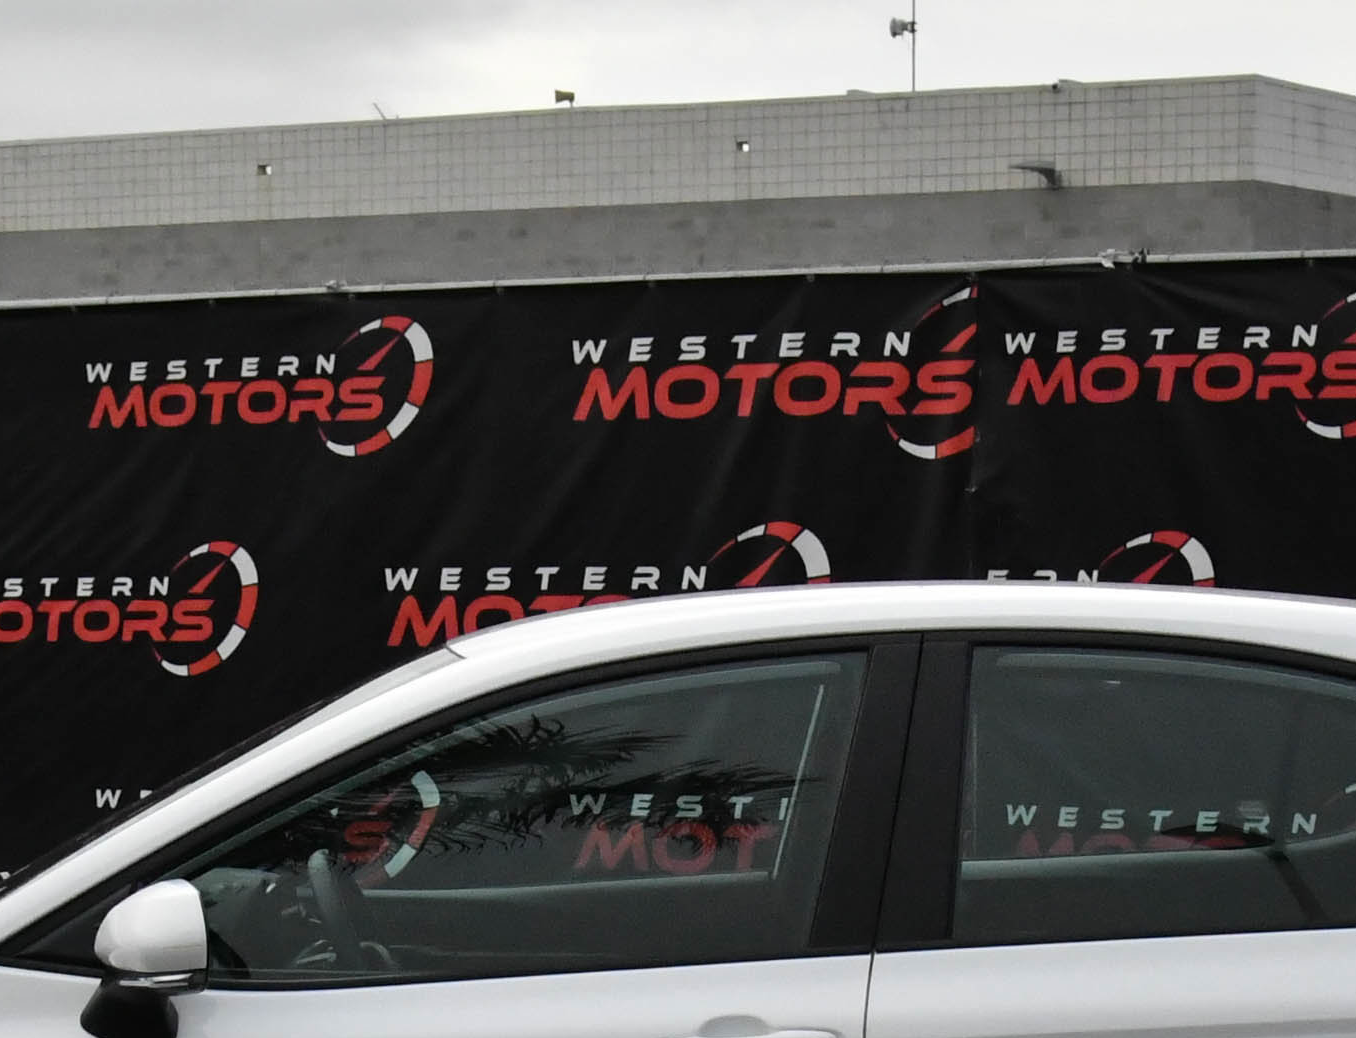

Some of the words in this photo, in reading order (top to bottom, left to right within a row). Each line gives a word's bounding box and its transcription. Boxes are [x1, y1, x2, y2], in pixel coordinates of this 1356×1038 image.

[573, 331, 911, 364] WESTERN
[1005, 324, 1318, 355] WESTERN
[86, 354, 336, 382] WESTERN
[88, 376, 385, 429] MOTORS
[573, 360, 975, 421] MOTORS
[384, 566, 707, 592] WESTERN
[1006, 804, 1318, 834] WESTERN
